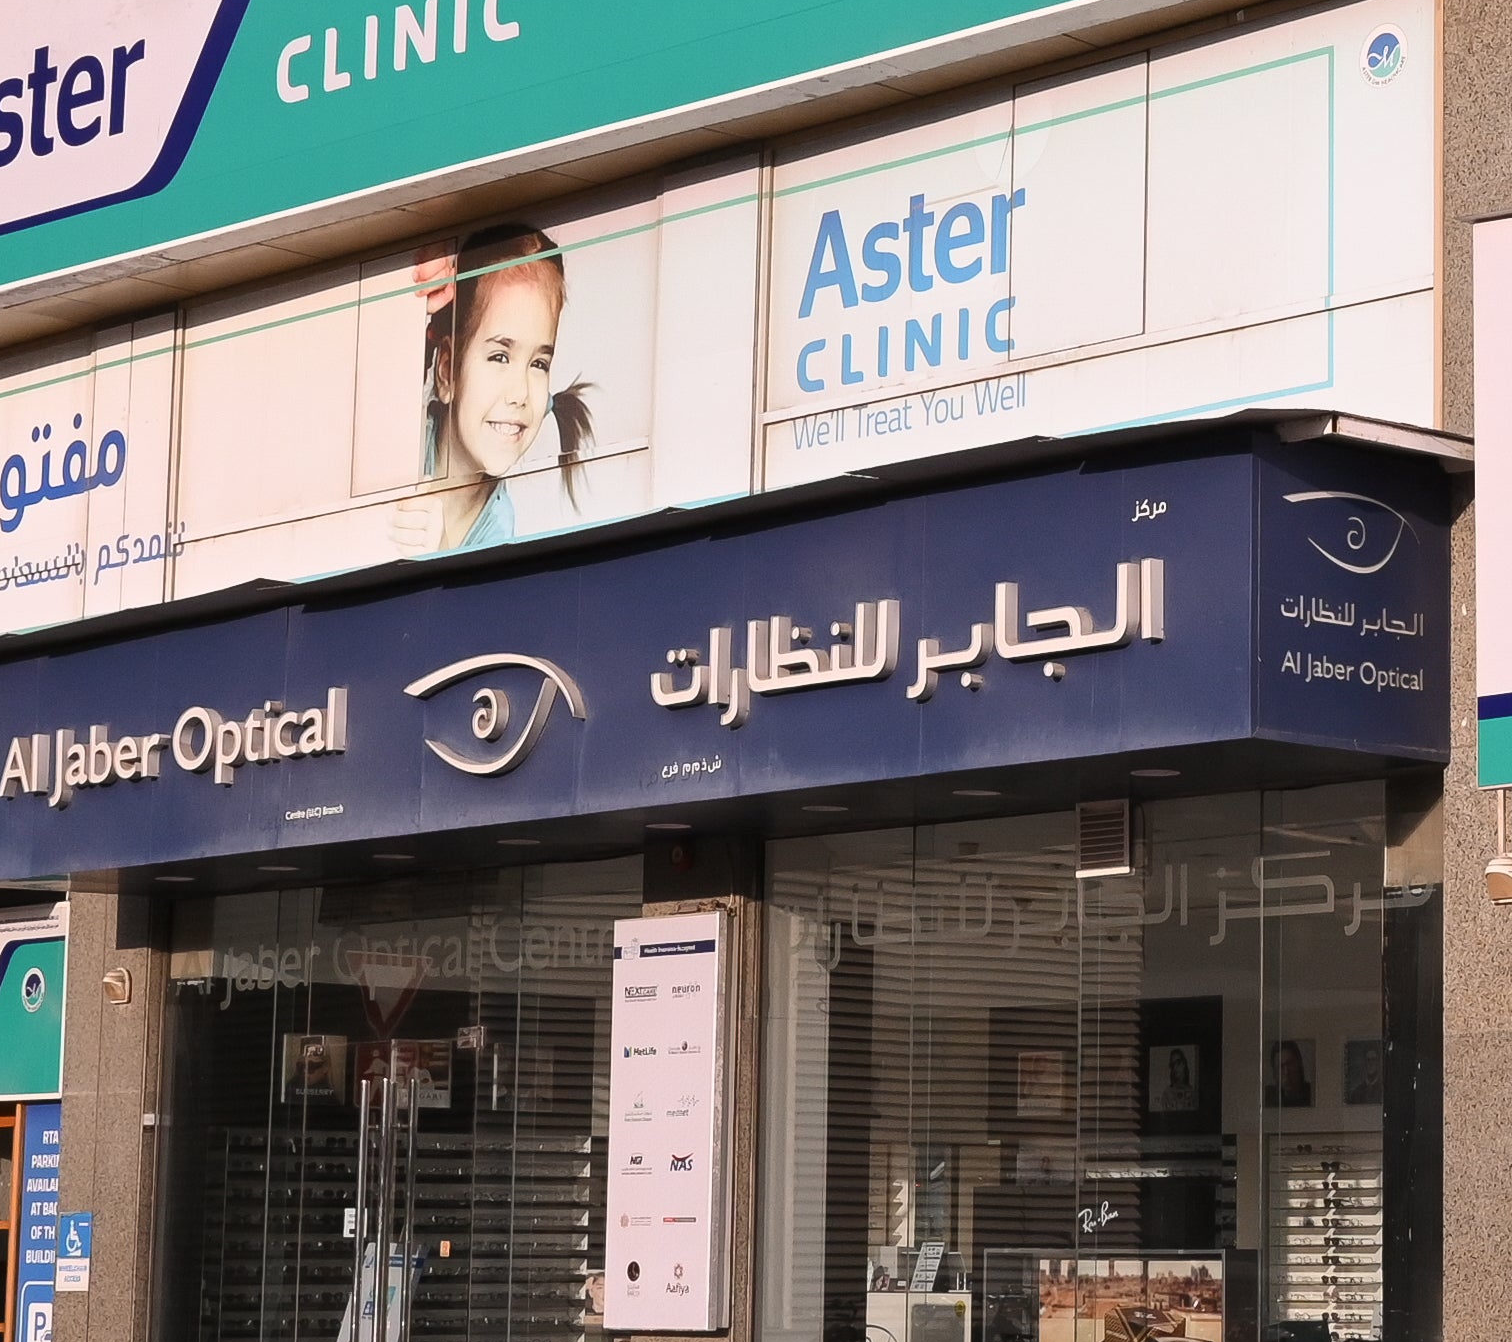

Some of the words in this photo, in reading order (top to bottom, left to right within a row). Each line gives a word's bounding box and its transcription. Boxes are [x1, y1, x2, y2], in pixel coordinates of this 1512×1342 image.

[797, 187, 1026, 319] Aster
[797, 296, 1015, 392] CLINIC
[852, 402, 913, 438] Treat
[920, 386, 964, 427] You
[973, 374, 1027, 417] Well
[1131, 499, 1167, 523] مركز
[907, 558, 1166, 701] الجابر
[1280, 595, 1355, 627] للنظارات
[1360, 607, 1424, 640] الجابر
[650, 599, 900, 728] للنظارات
[1281, 650, 1301, 675] Al
[1305, 653, 1355, 683] Jaber
[1359, 661, 1424, 693] Optical
[48, 725, 170, 809] Jaber
[172, 687, 348, 787] Optical
[333, 927, 481, 1001] Optical
[43, 1130, 59, 1145] RTA
[670, 1159, 694, 1172] NAS
[30, 1202, 43, 1216] AT
[30, 1226, 43, 1239] OF
